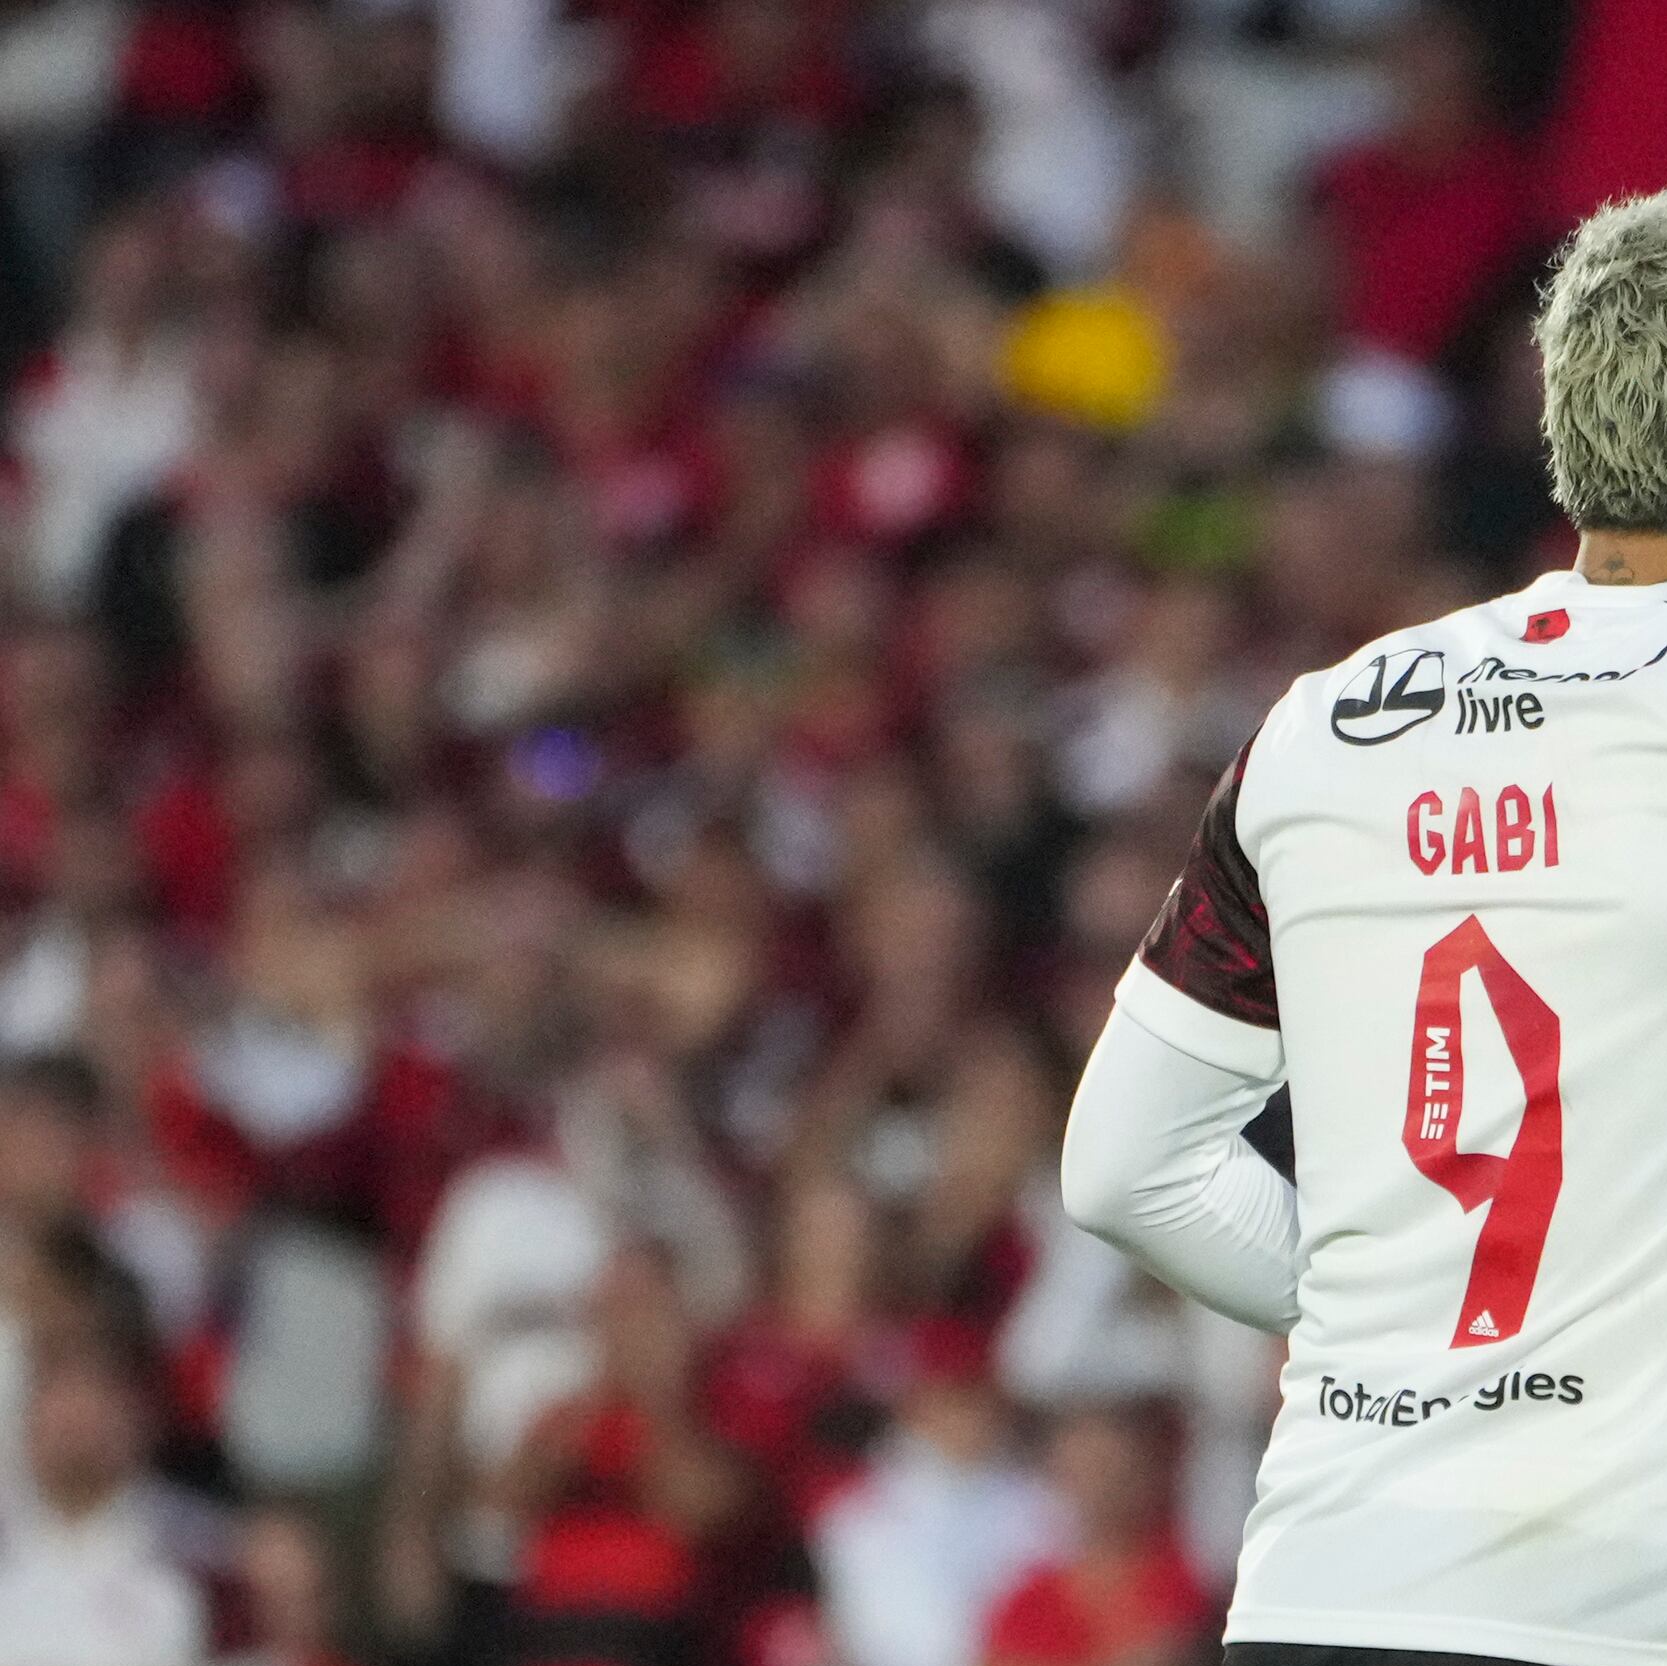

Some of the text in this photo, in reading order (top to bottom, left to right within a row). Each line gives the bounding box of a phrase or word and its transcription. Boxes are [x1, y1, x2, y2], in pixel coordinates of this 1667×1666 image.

[1455, 688, 1545, 734] livre
[1406, 781, 1559, 876] GABI
[1425, 1027, 1451, 1097] TIM
[1401, 913, 1563, 1350] 9
